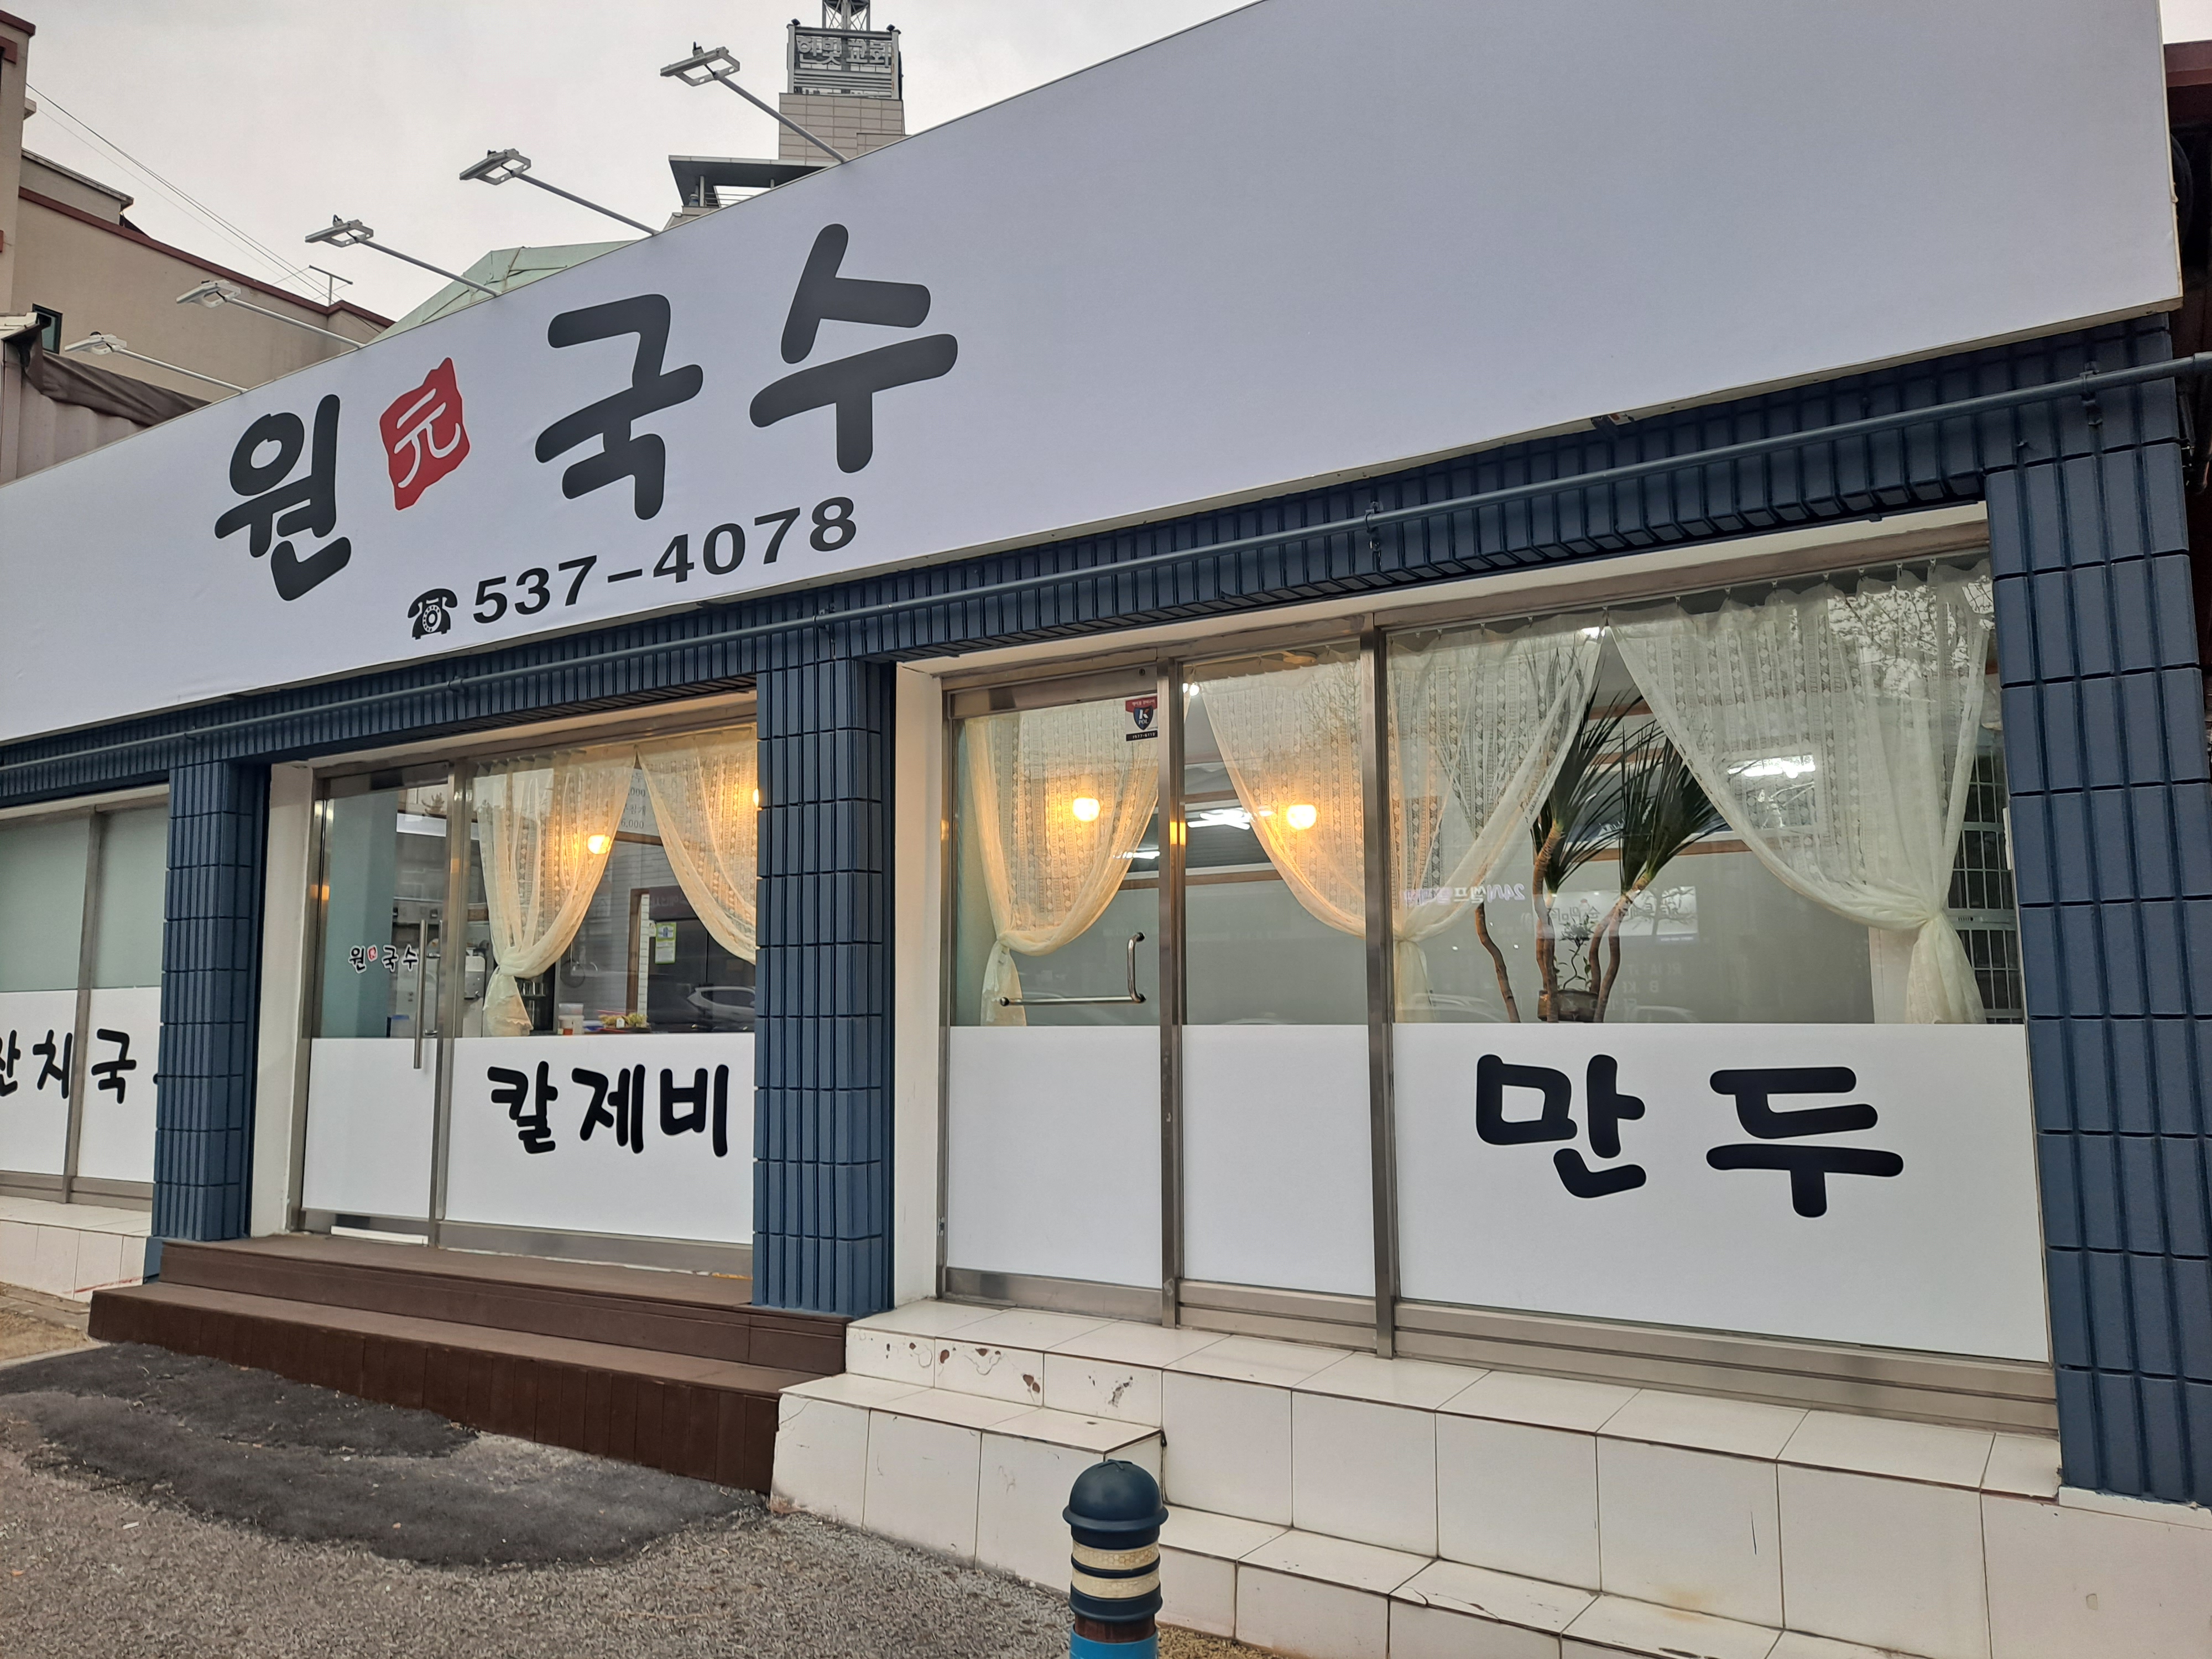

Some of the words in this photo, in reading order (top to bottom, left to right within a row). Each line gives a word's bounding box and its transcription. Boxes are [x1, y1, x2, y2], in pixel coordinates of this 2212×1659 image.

[846, 39, 890, 67] 교회
[215, 394, 351, 601] 원
[535, 223, 958, 514] 국수
[473, 497, 857, 624] 537-4078
[349, 947, 366, 971] 원
[383, 946, 418, 971] 국수
[0, 1029, 158, 1104] 치국
[487, 1061, 729, 1157] 칼제비
[1475, 1054, 1904, 1218] 만두
